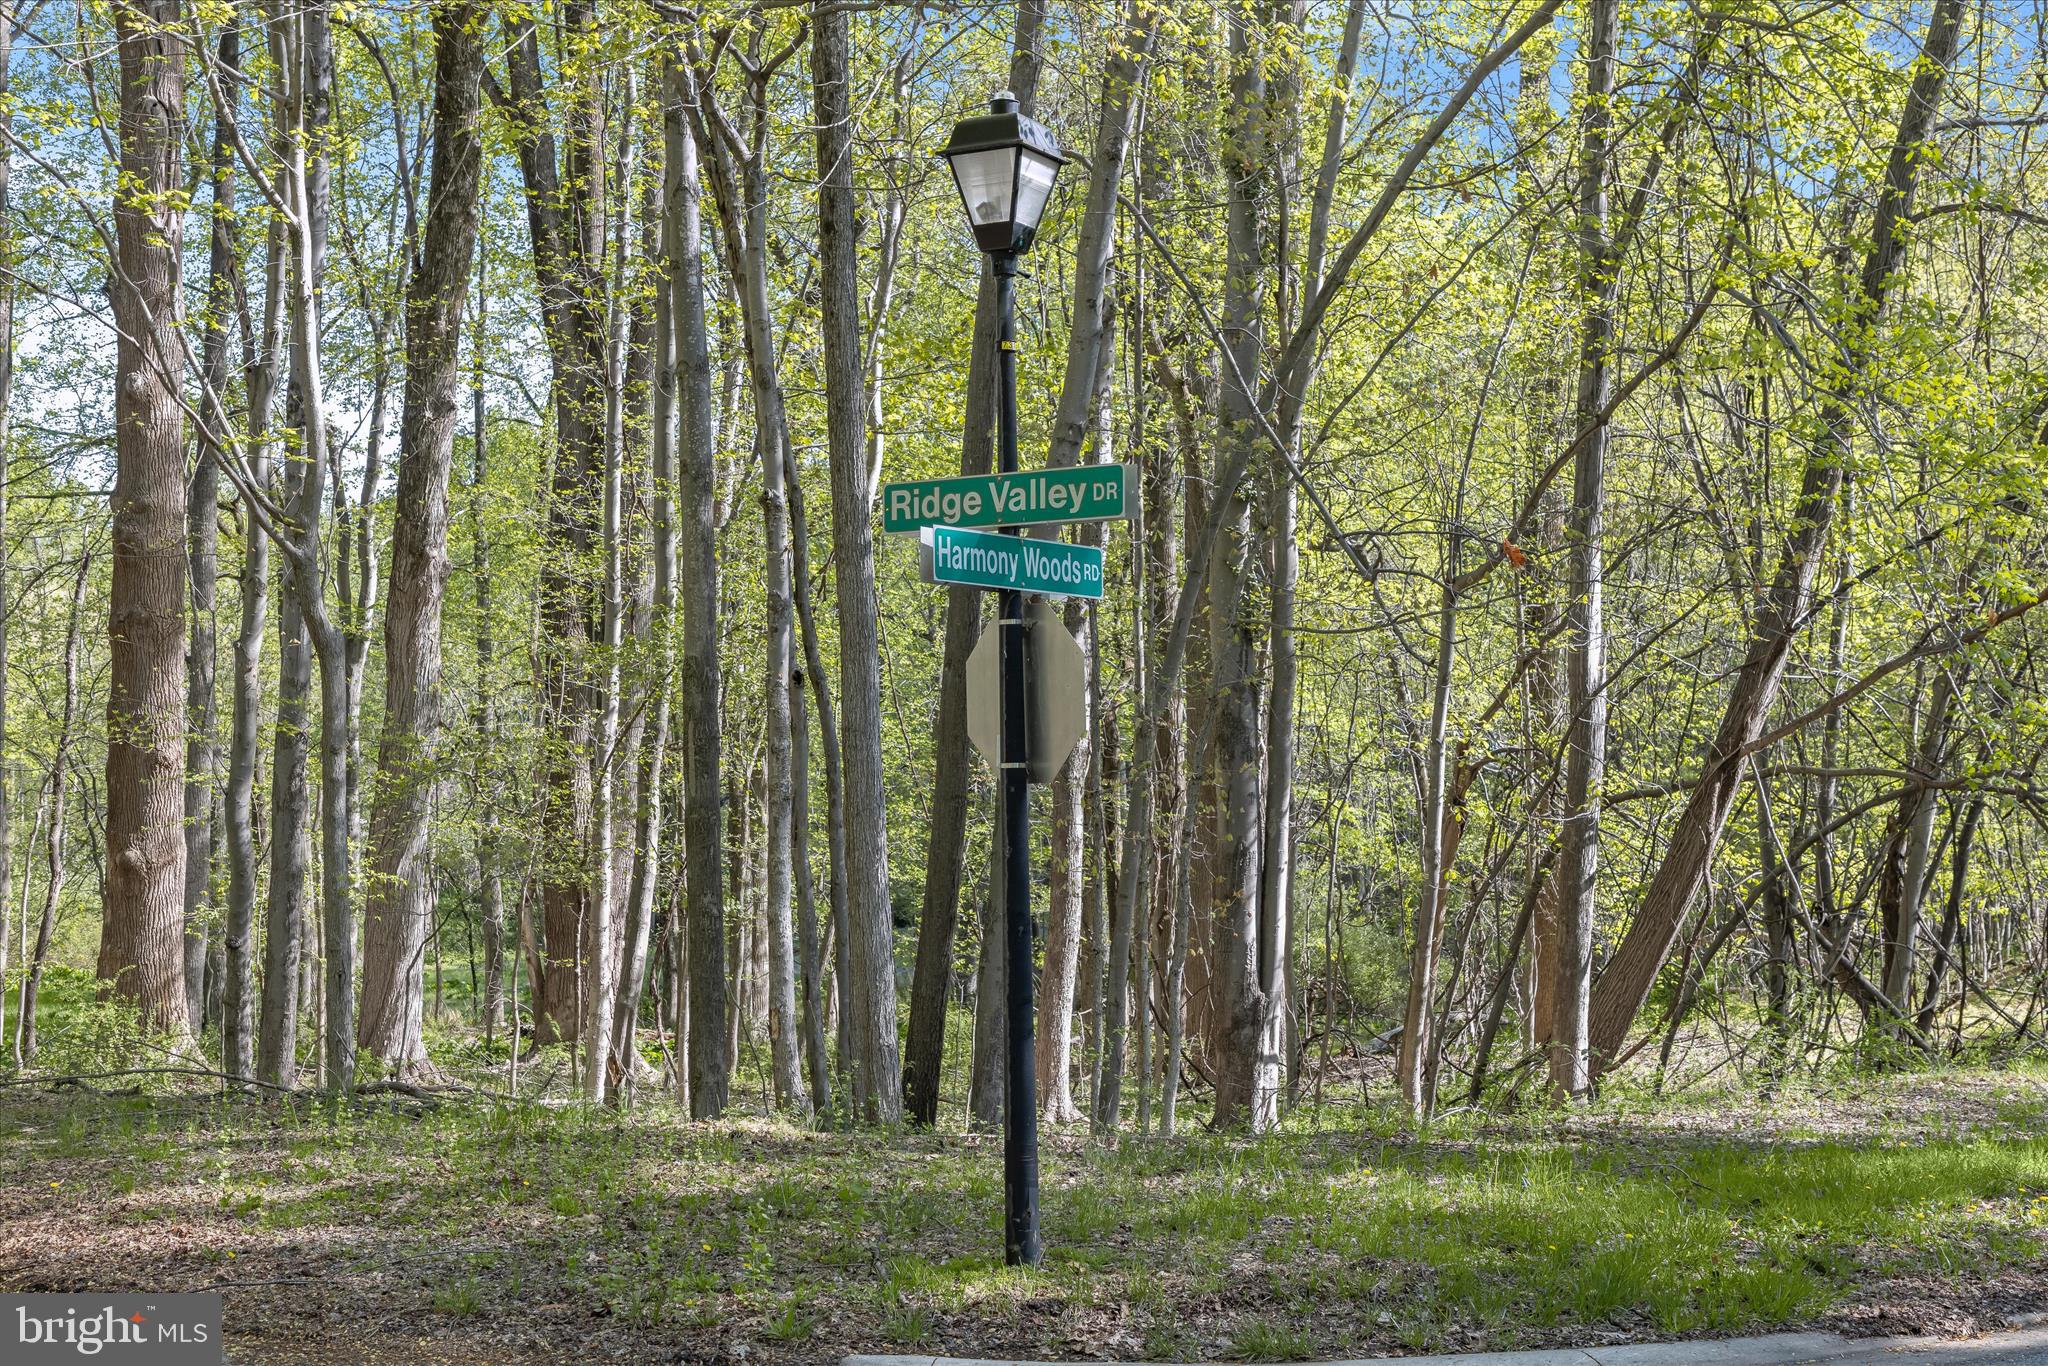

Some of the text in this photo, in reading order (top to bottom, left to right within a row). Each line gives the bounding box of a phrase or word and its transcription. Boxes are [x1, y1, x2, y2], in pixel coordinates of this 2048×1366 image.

[891, 478, 1118, 523] Ridge Valley DR
[938, 535, 1100, 583] Harmony Woods RD
